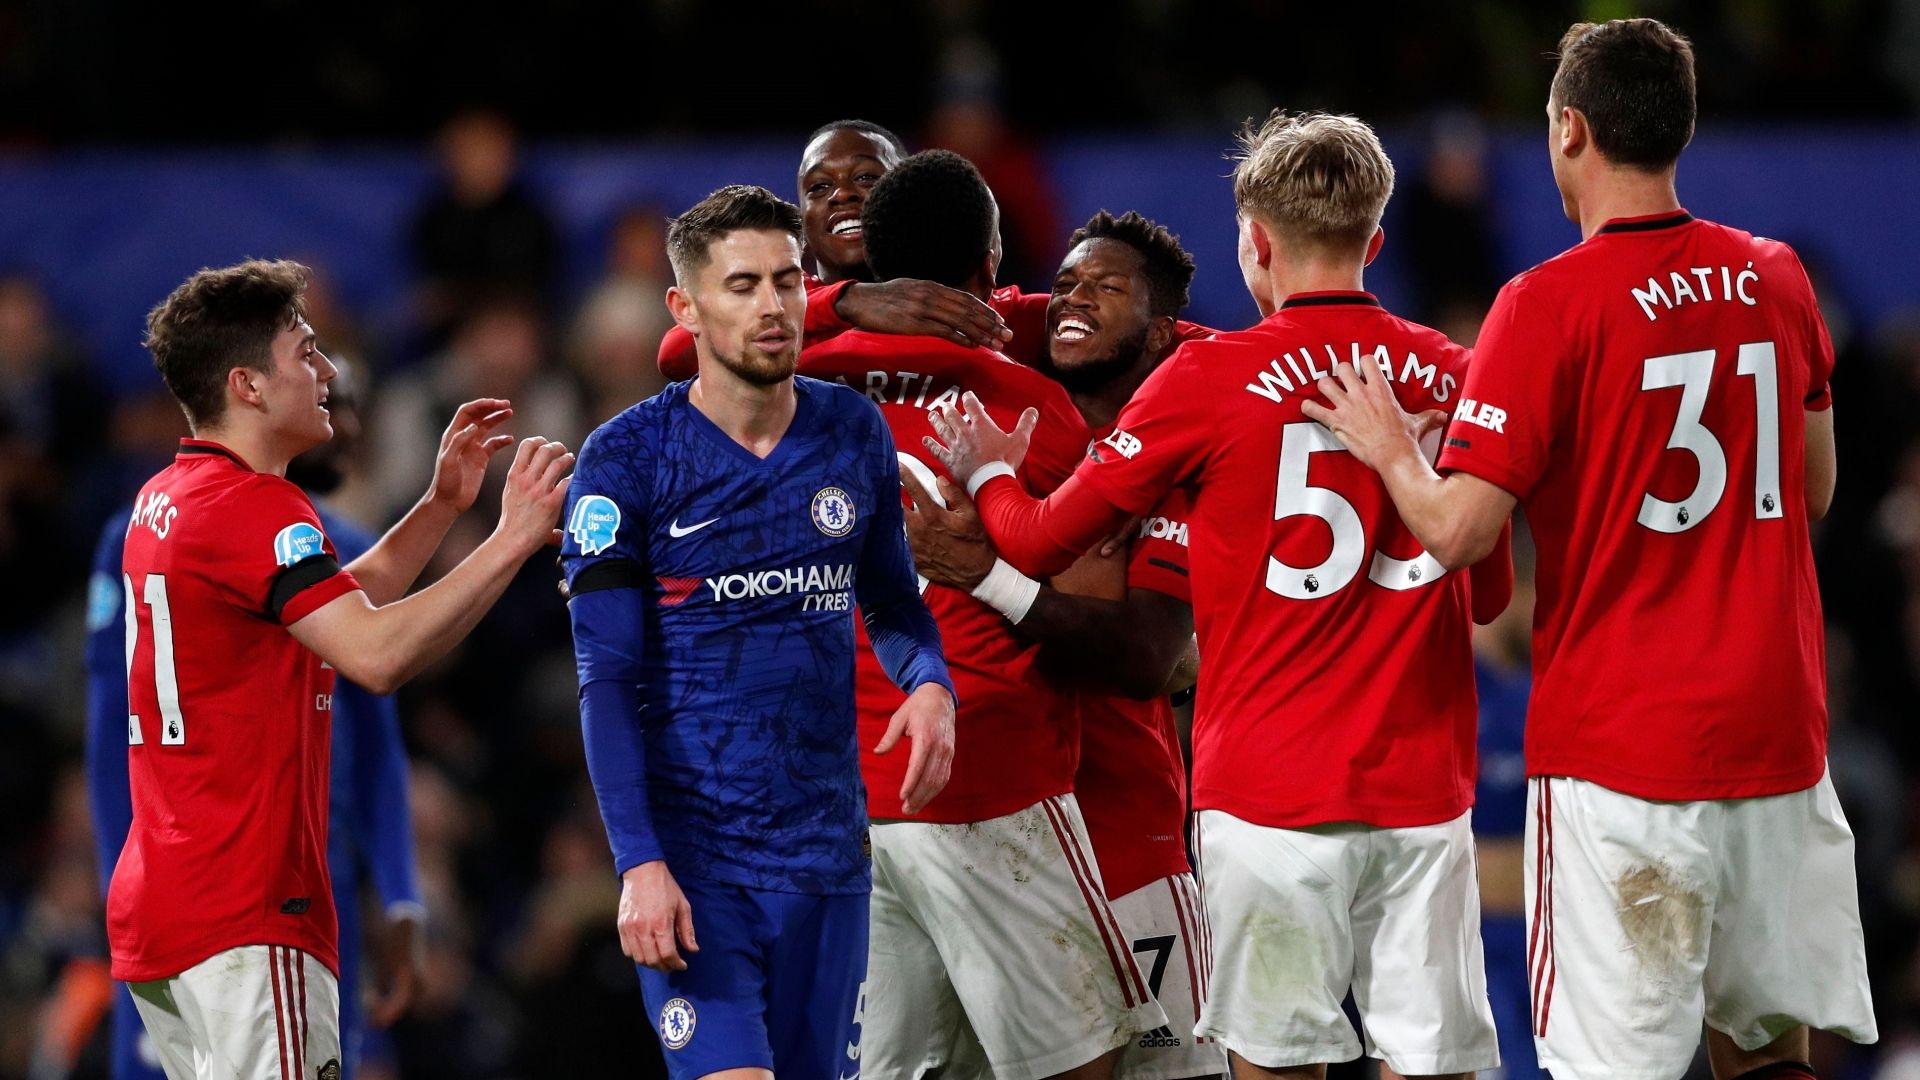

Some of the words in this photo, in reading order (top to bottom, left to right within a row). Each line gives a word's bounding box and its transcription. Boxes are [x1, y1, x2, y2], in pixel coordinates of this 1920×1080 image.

[1631, 261, 1759, 321] MATIĆ
[1246, 342, 1457, 404] WILLIAMS
[835, 370, 970, 424] RTIA
[1637, 341, 1784, 534] 31
[817, 489, 845, 500] CHELSEA
[125, 490, 178, 540] AMES
[587, 511, 615, 522] Heads
[587, 521, 600, 532] Up
[294, 533, 319, 546] Heads
[298, 543, 311, 554] Up
[705, 564, 853, 602] YOKOHAMA
[802, 592, 849, 611] TYRES
[1132, 934, 1177, 1001] 7
[1138, 1036, 1181, 1049] adidas
